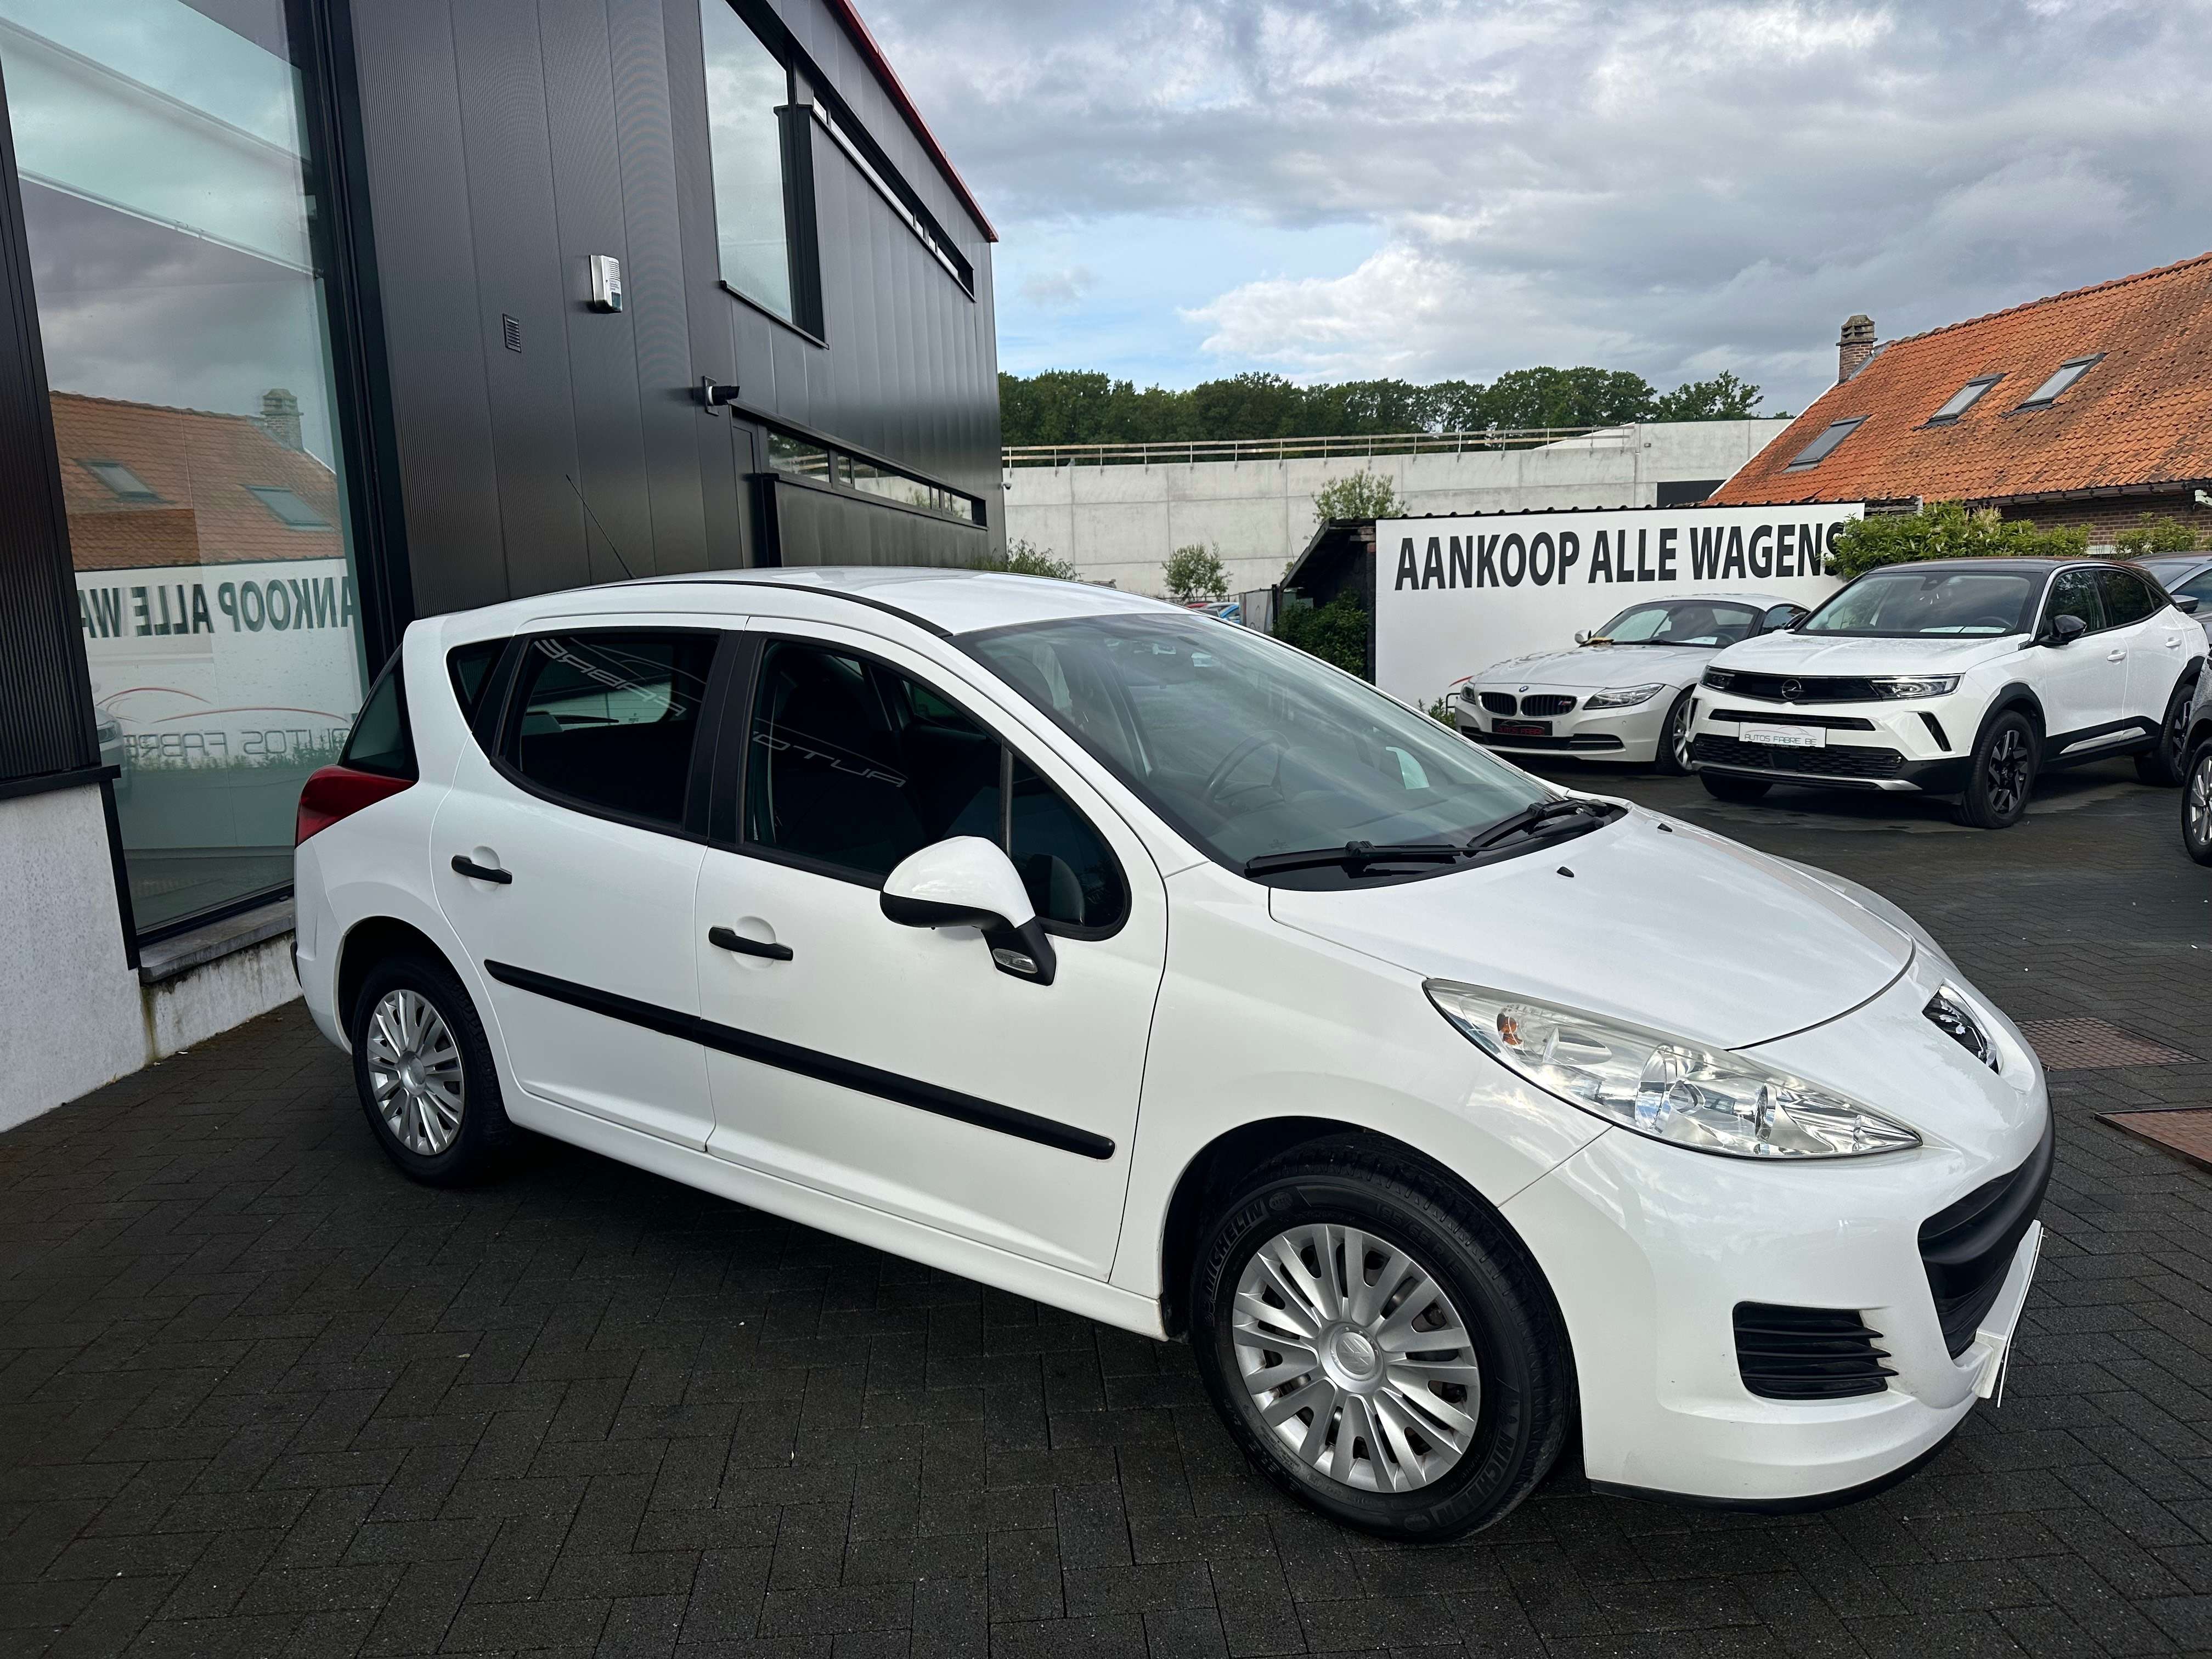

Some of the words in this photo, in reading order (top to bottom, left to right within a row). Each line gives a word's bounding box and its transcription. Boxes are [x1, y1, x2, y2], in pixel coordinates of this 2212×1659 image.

[1395, 531, 1581, 591] AANKOOP
[1588, 527, 1678, 584] ALLE
[1744, 733, 1770, 742] AUTOS
[1773, 736, 1801, 744] FABRE
